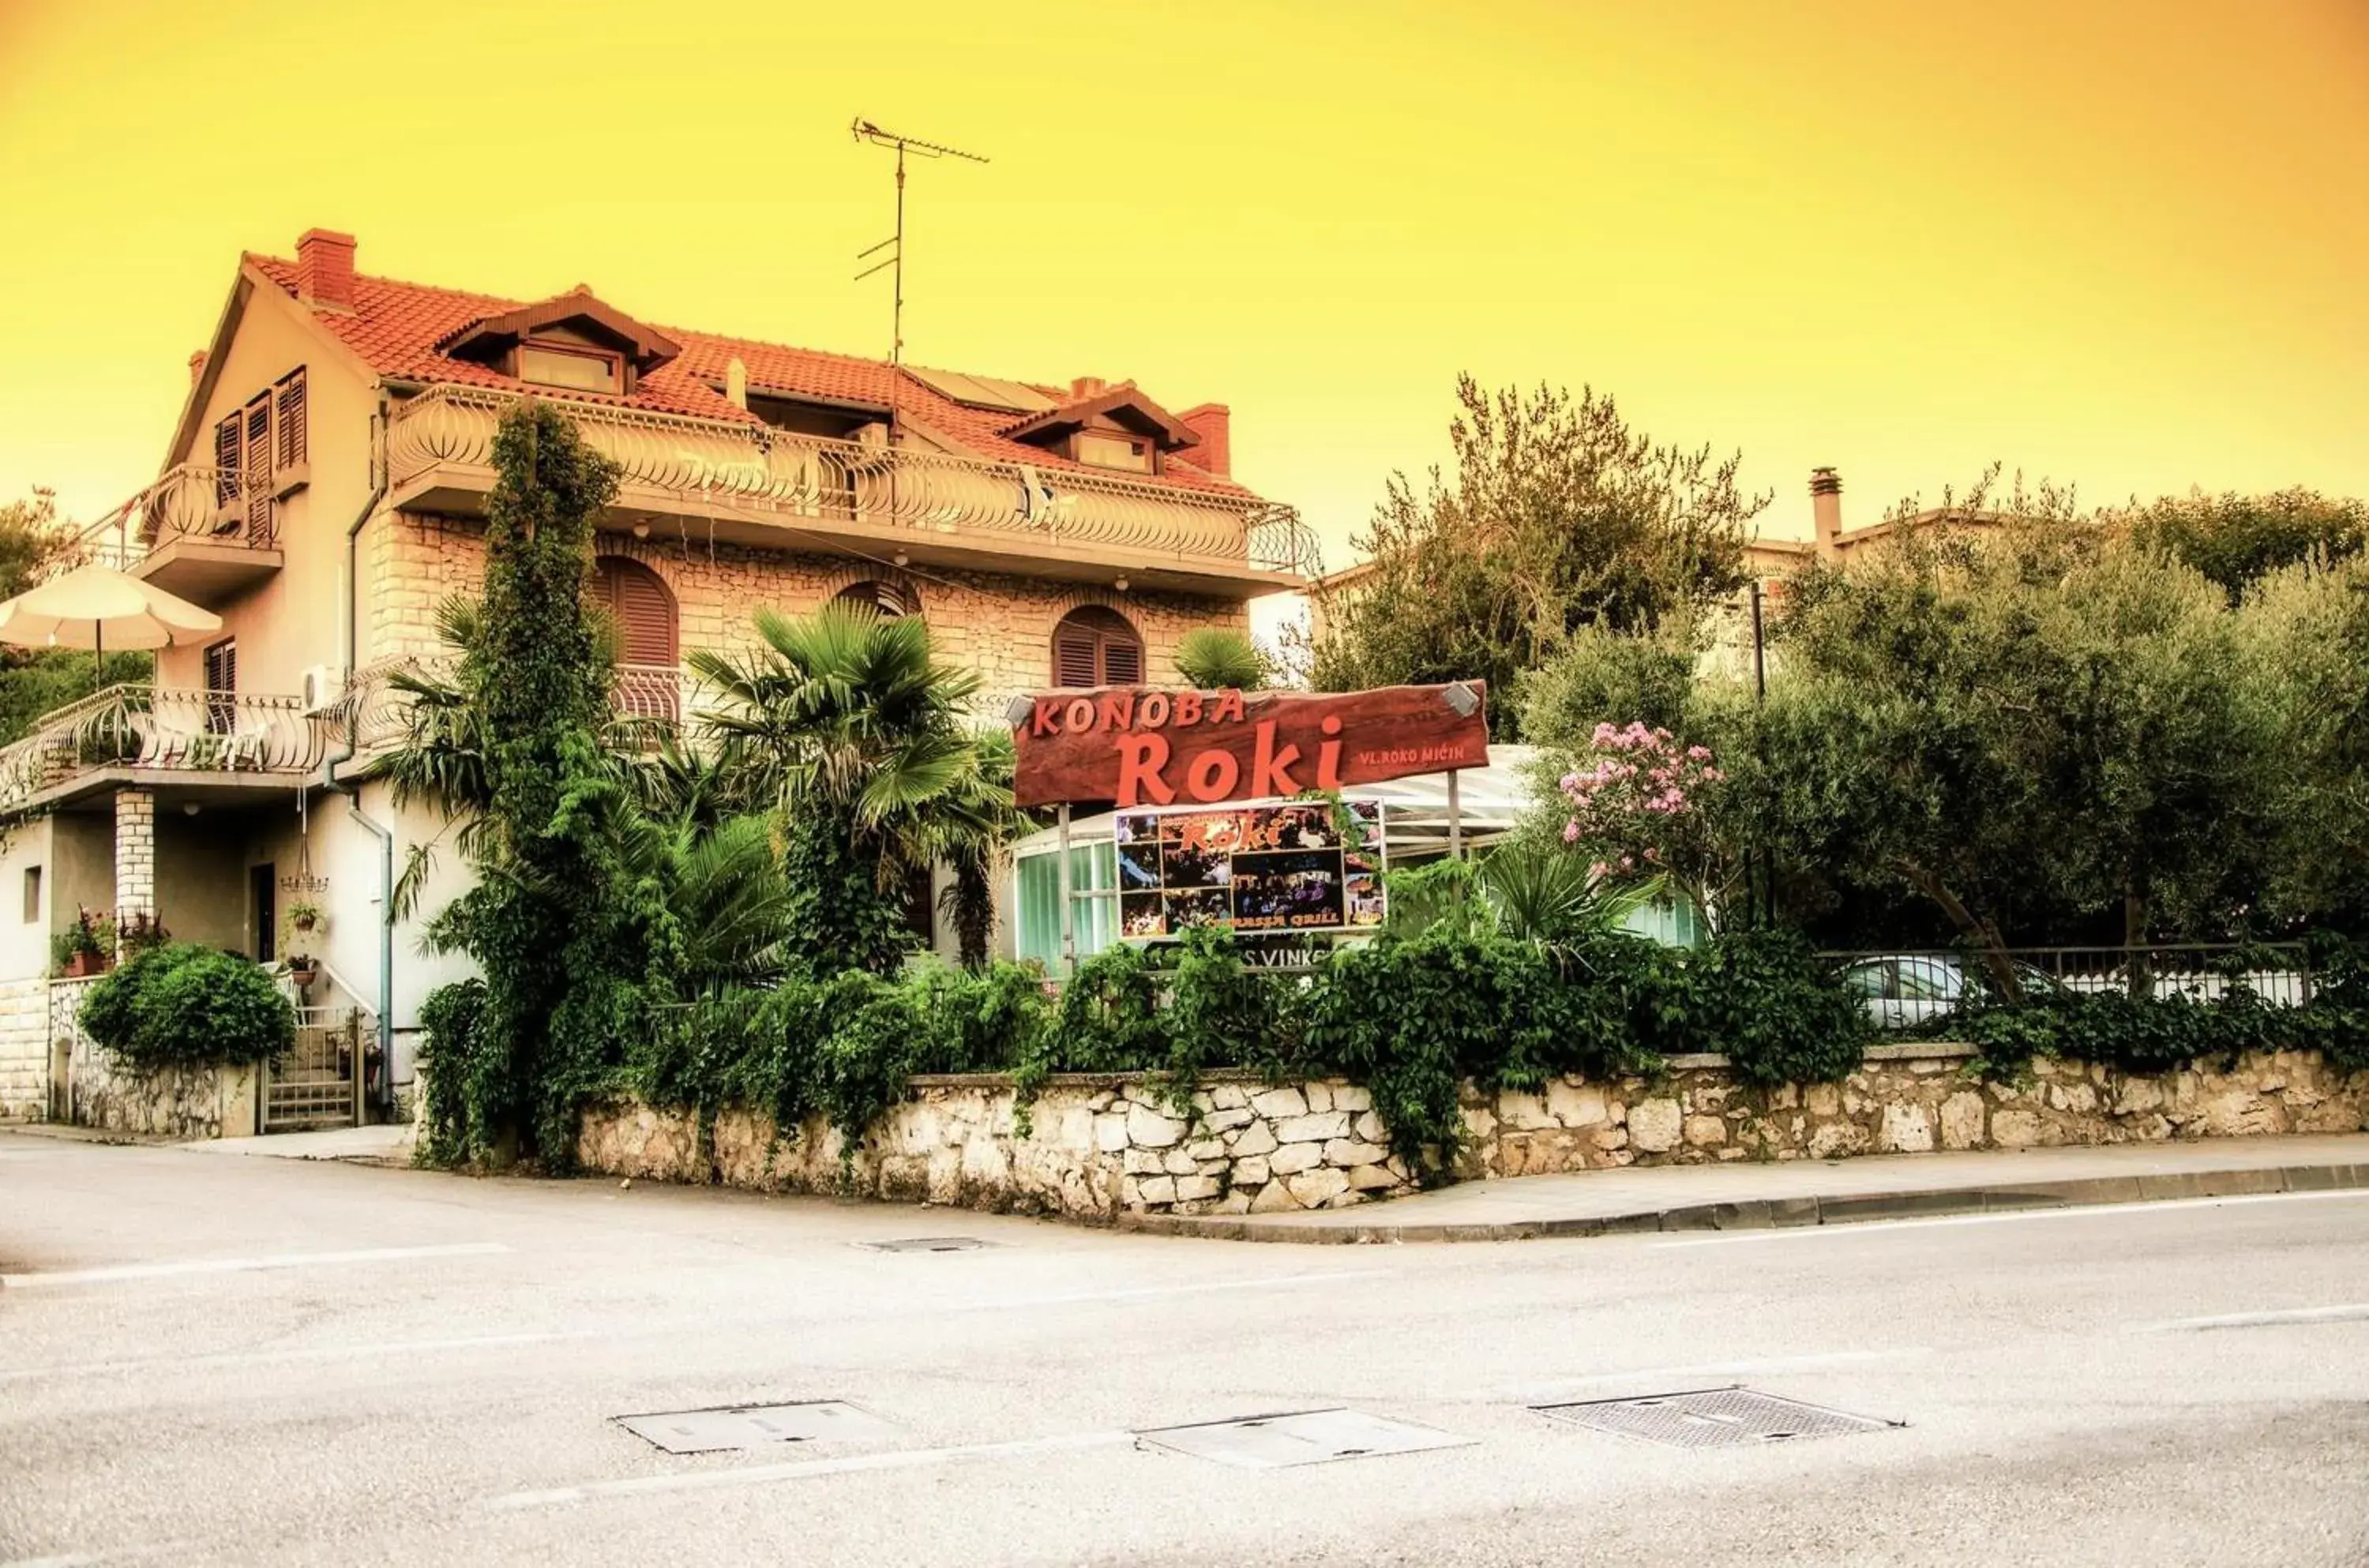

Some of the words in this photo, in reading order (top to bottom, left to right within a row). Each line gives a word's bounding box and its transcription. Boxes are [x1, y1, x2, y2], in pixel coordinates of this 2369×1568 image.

[1033, 687, 1245, 737] KONOBA
[1114, 715, 1342, 808] Roki
[1181, 812, 1285, 851] Roki
[1290, 913, 1340, 926] GRILL
